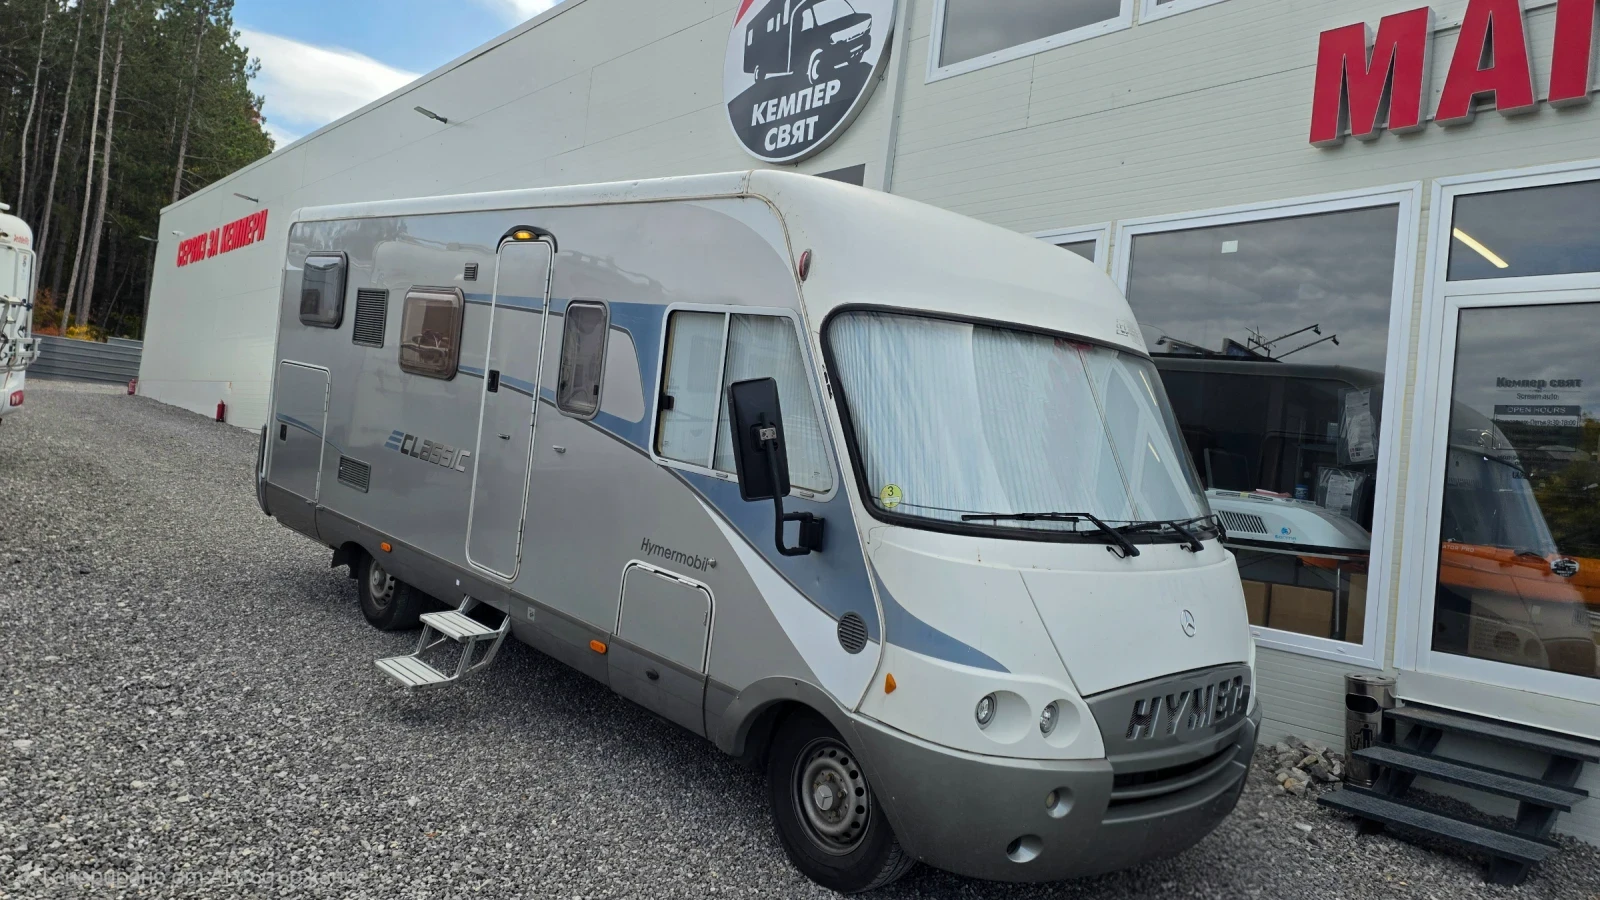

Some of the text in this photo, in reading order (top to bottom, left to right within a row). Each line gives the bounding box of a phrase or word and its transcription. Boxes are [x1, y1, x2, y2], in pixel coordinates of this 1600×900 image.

[751, 79, 841, 127] КЕМПЕР
[764, 115, 819, 151] СВЯТ
[177, 208, 269, 268] СЕРВИЗ ЗА КЕМПЕРИ
[1496, 377, 1582, 390] Кемпер свят
[1507, 406, 1566, 414] OPEN HOURS
[887, 485, 894, 497] 3
[640, 537, 709, 572] Hymermobil
[1125, 674, 1244, 741] HYMER
